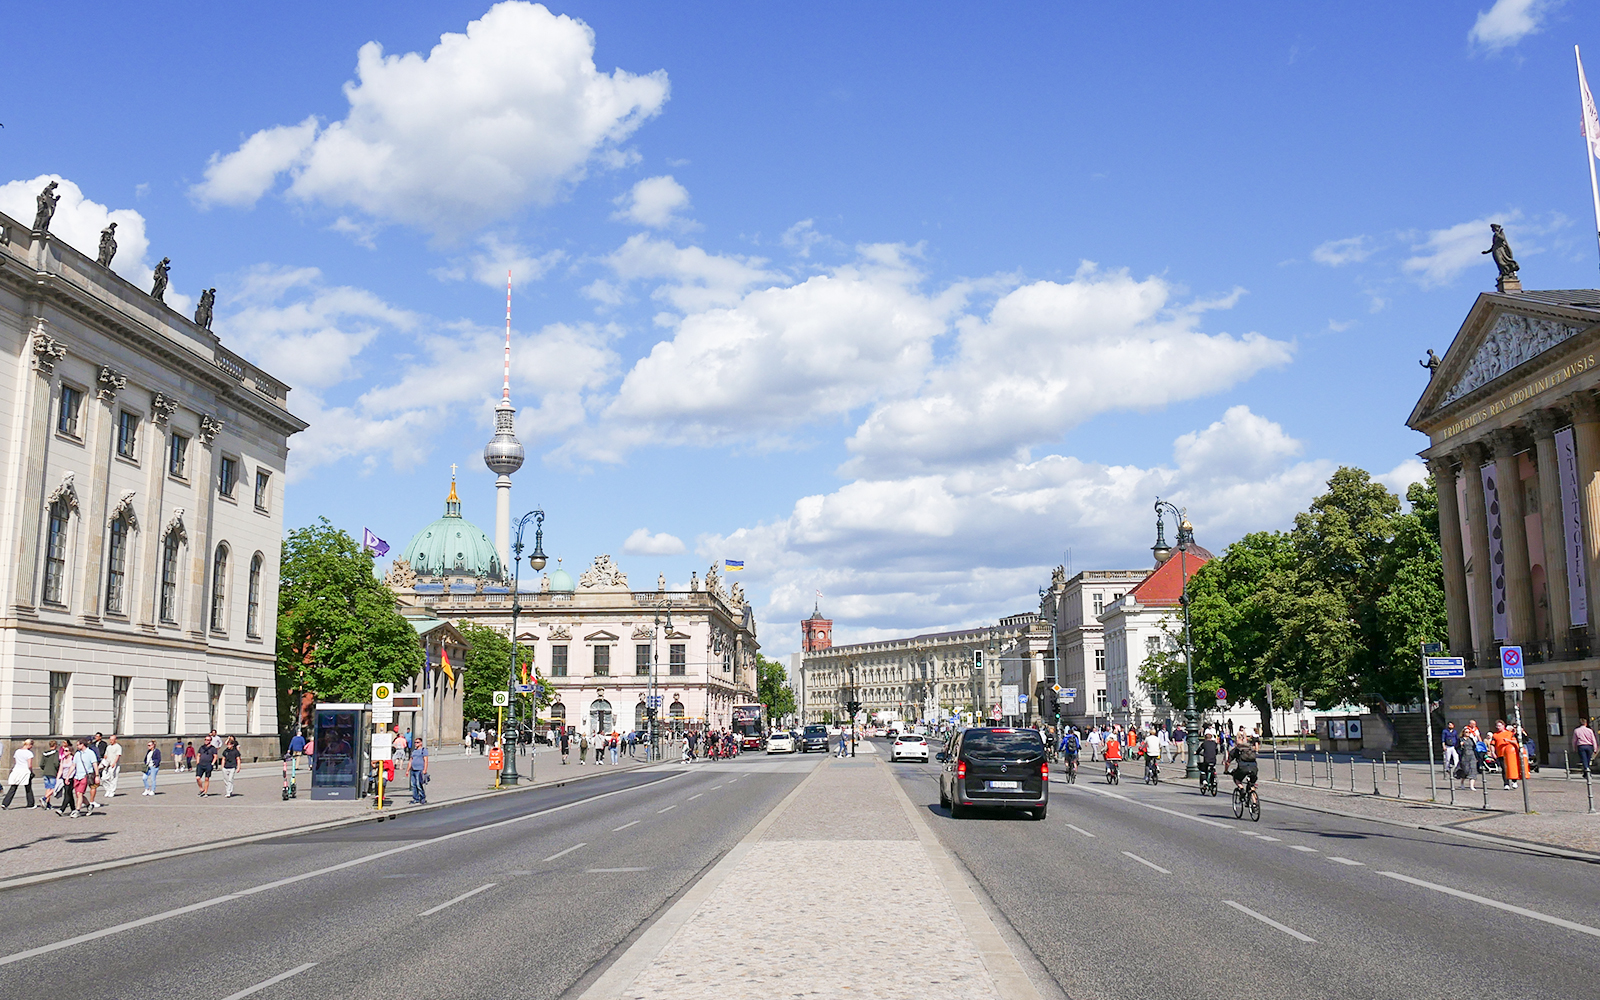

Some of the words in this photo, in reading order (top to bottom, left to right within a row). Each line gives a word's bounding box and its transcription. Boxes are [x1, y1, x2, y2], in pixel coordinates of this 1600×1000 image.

[1443, 408, 1488, 440] FRIDERICVS
[1489, 399, 1508, 417] REX
[1508, 377, 1549, 408] APOLLINI
[1551, 373, 1562, 386] ET
[1562, 354, 1596, 380] MVSIS
[1504, 667, 1522, 675] TAXI
